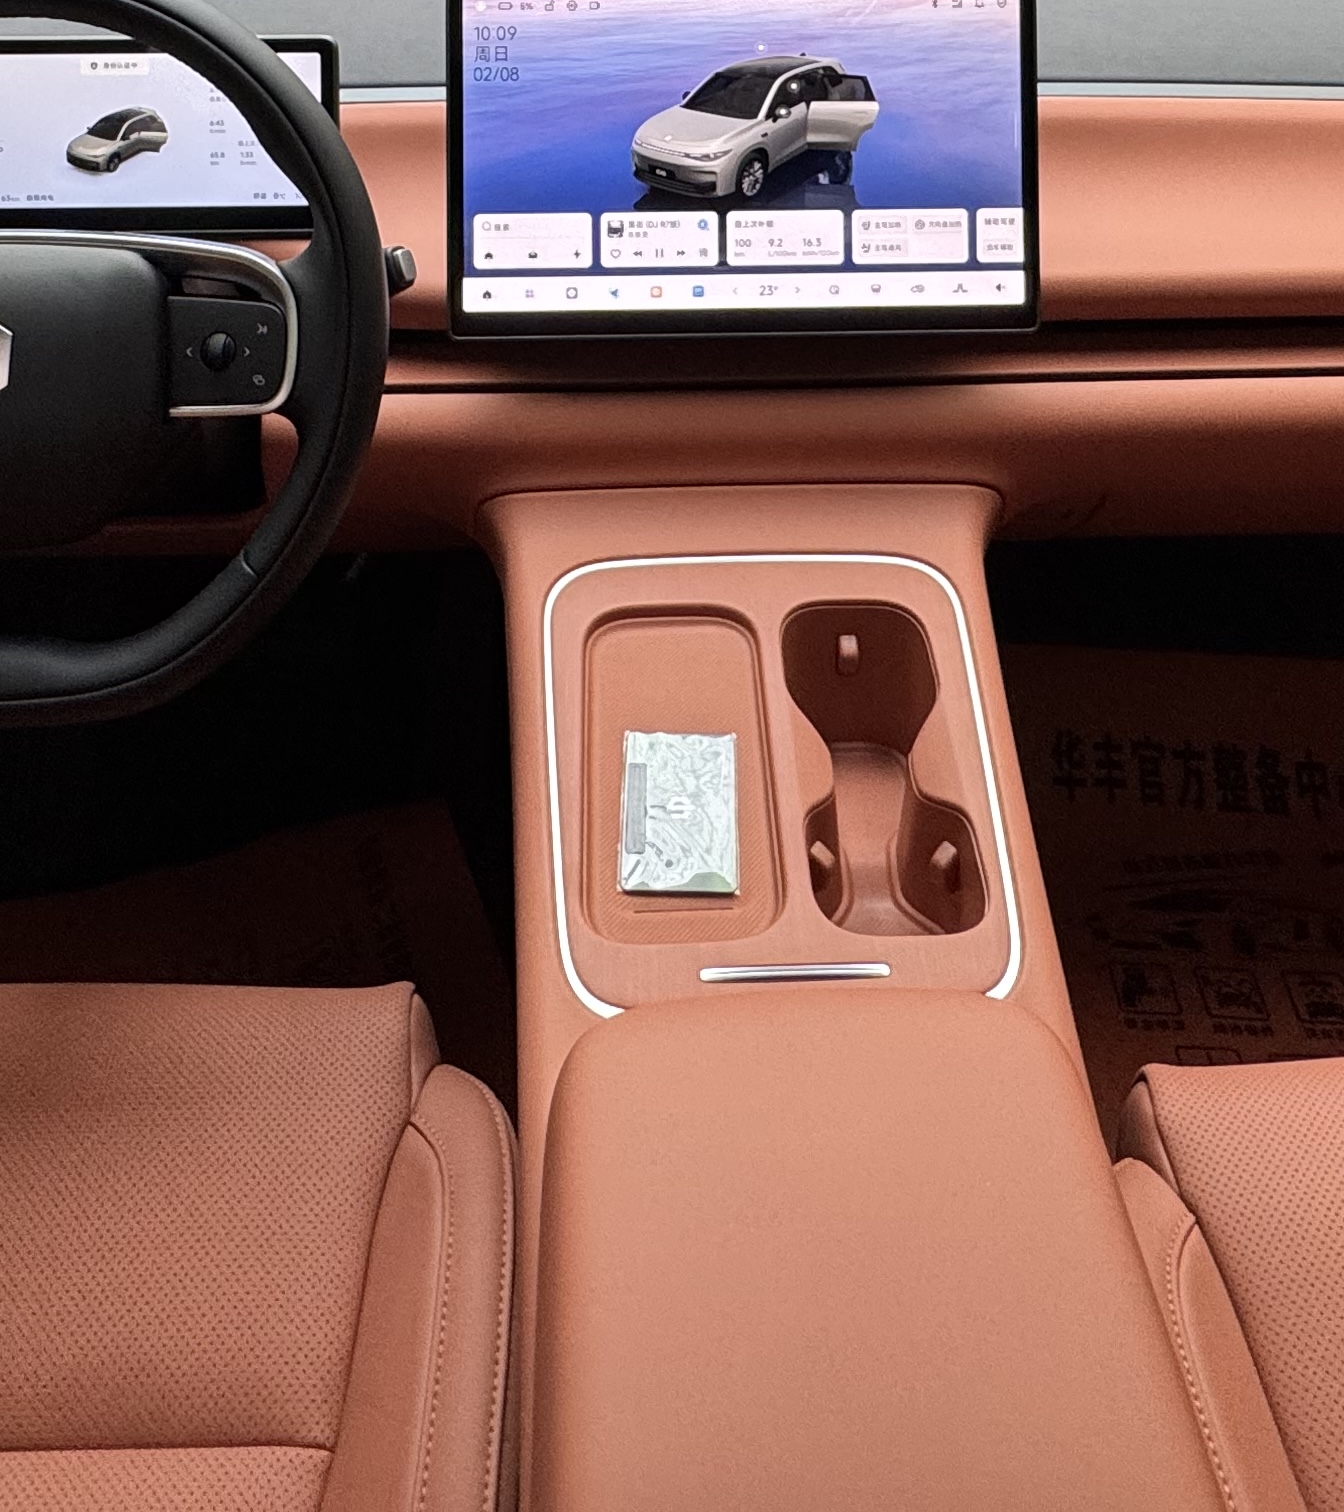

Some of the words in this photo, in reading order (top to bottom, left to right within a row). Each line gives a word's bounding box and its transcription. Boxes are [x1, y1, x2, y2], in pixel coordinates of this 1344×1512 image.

[474, 26, 517, 41] 10:09
[474, 46, 508, 62] 周日
[473, 67, 520, 82] 02/08
[734, 238, 752, 248] 100
[767, 238, 784, 248] 9.2
[802, 237, 823, 248] 16.3
